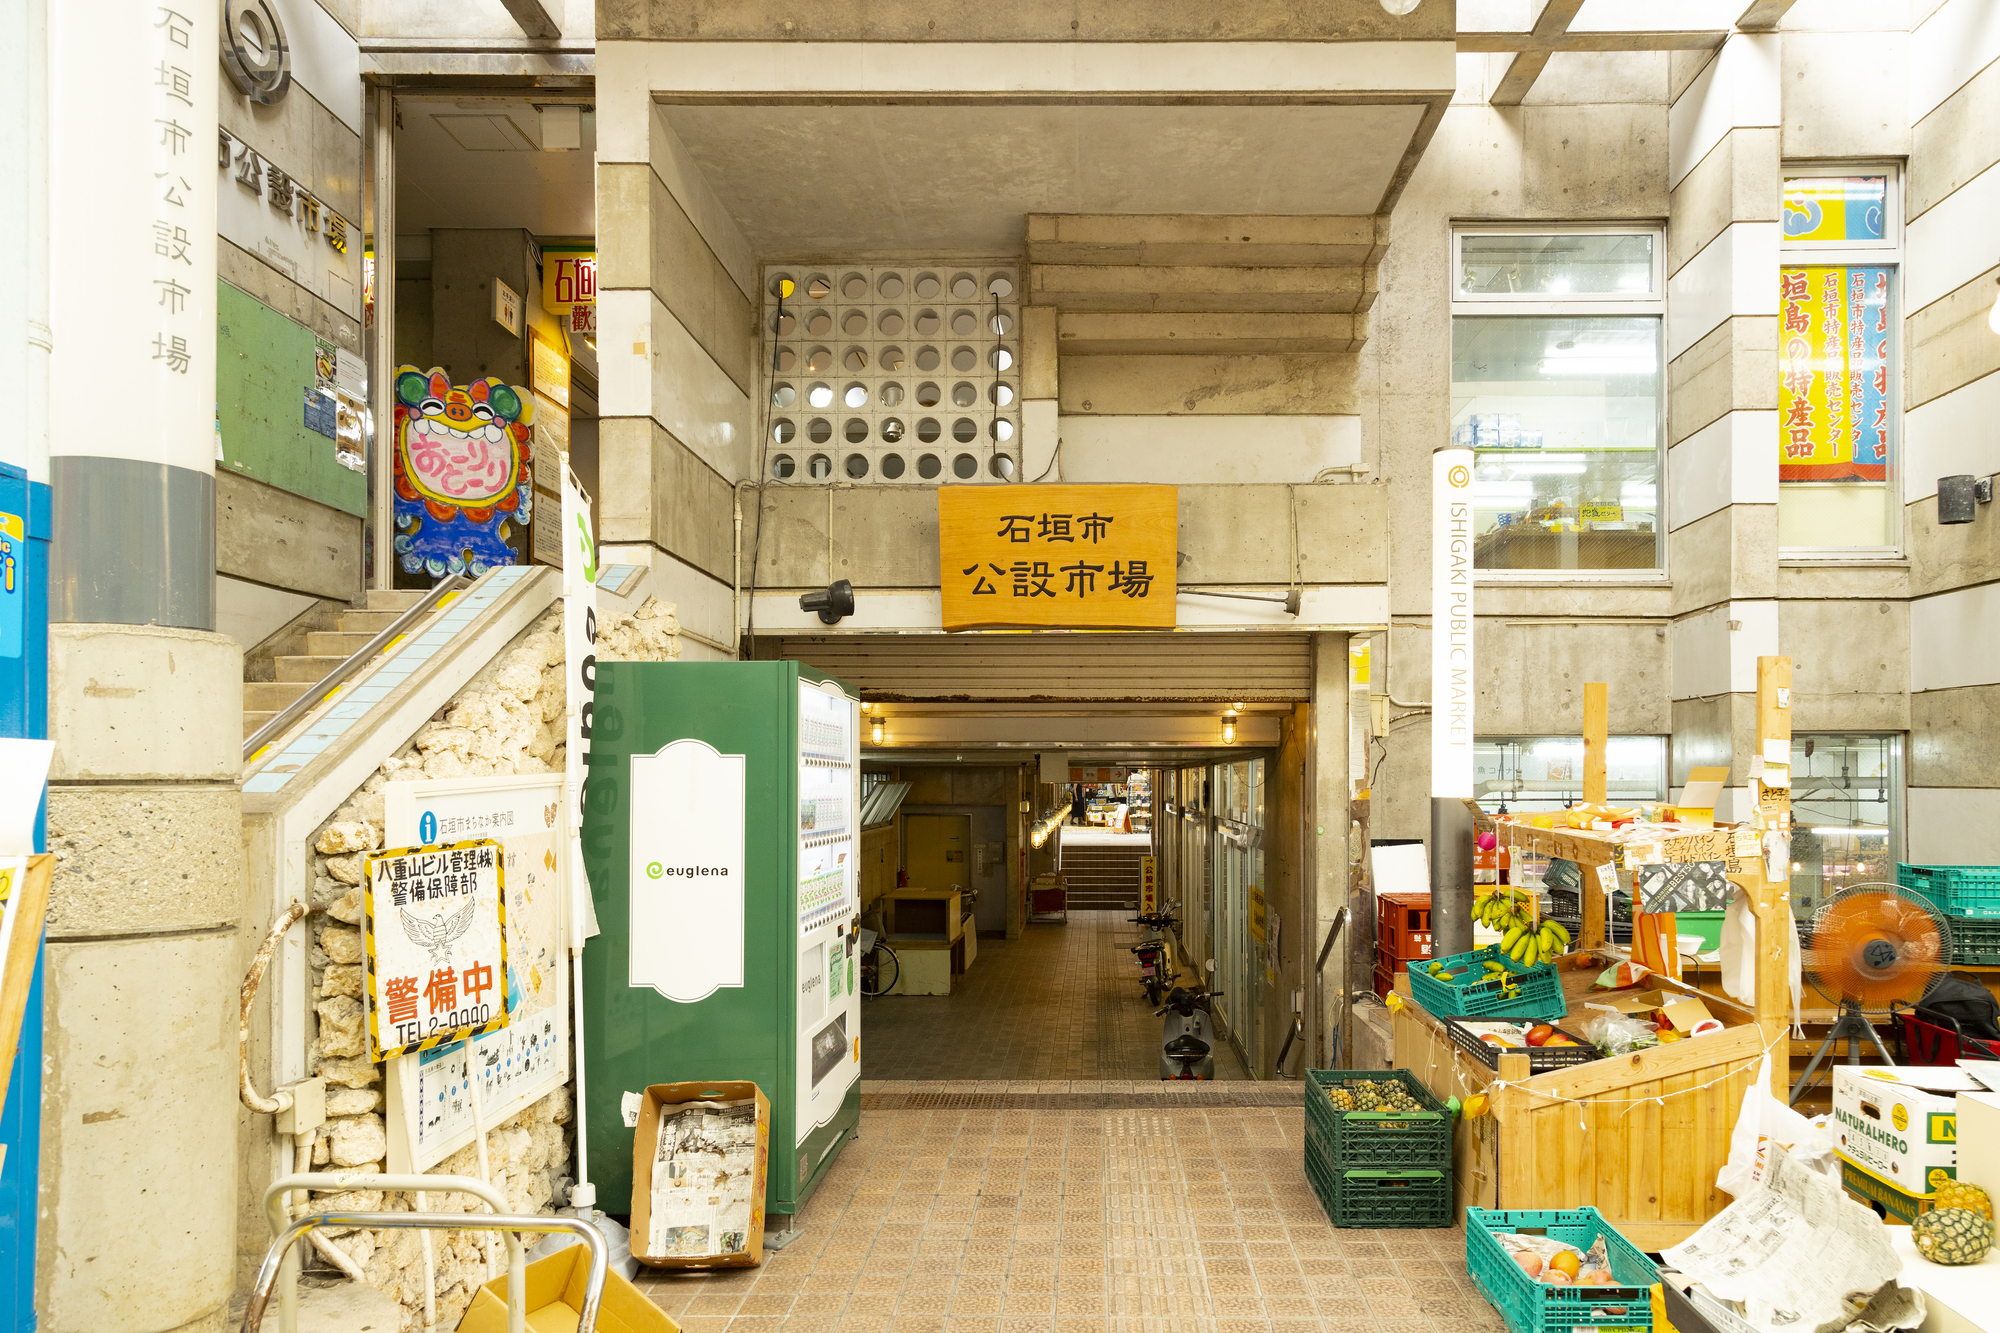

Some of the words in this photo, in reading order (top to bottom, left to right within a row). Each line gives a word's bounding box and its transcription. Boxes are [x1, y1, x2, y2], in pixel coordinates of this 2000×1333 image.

[152, 6, 194, 375] 石垣市公設市場
[554, 256, 596, 303] 石垣
[1780, 268, 1816, 459] 垣島の特産品
[997, 511, 1114, 544] 石垣市
[1450, 502, 1468, 585] ISHIGAKI
[963, 560, 1155, 599] 公設市場
[1450, 592, 1467, 660] PUBLIC
[1450, 669, 1467, 749] MARKET
[439, 810, 514, 835] 石垣市まちなか案内図
[1664, 834, 1715, 847] スナックパイン
[391, 872, 478, 906] 警備保障部
[666, 865, 729, 879] euglena
[1145, 866, 1153, 916] 公設市場入
[385, 960, 493, 1025] 警備中
[802, 974, 821, 994] euglena
[1835, 1106, 1908, 1154] NATURALHERO
[1844, 1168, 1877, 1197] PREMIUM
[1878, 1187, 1916, 1219] BANANAS
